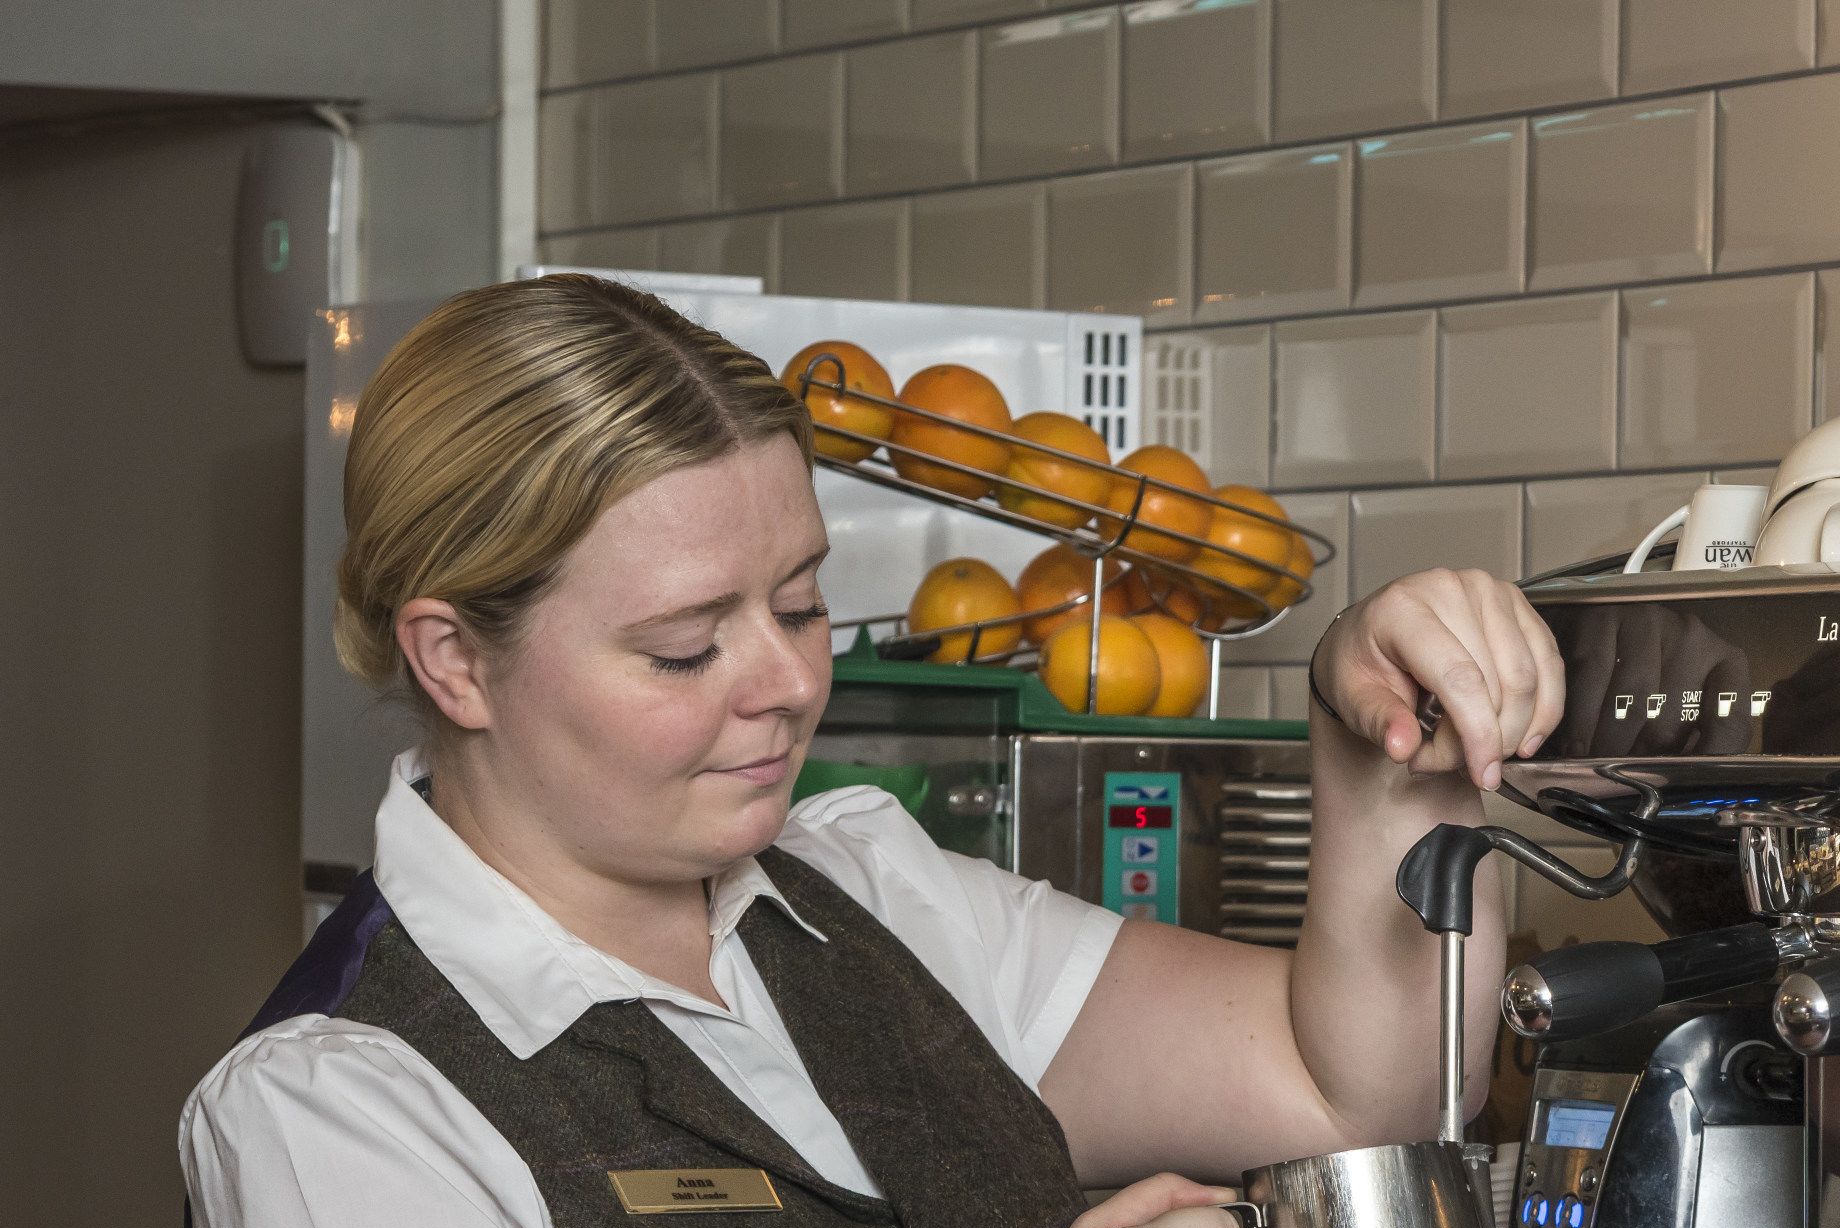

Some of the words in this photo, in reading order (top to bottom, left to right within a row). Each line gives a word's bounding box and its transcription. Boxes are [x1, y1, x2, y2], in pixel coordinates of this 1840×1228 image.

[1817, 616, 1838, 641] La
[1682, 691, 1702, 703] START
[1680, 709, 1699, 721] STOP
[677, 1177, 714, 1188] Anna
[672, 1192, 694, 1200] Shift
[697, 1192, 728, 1200] Leader
